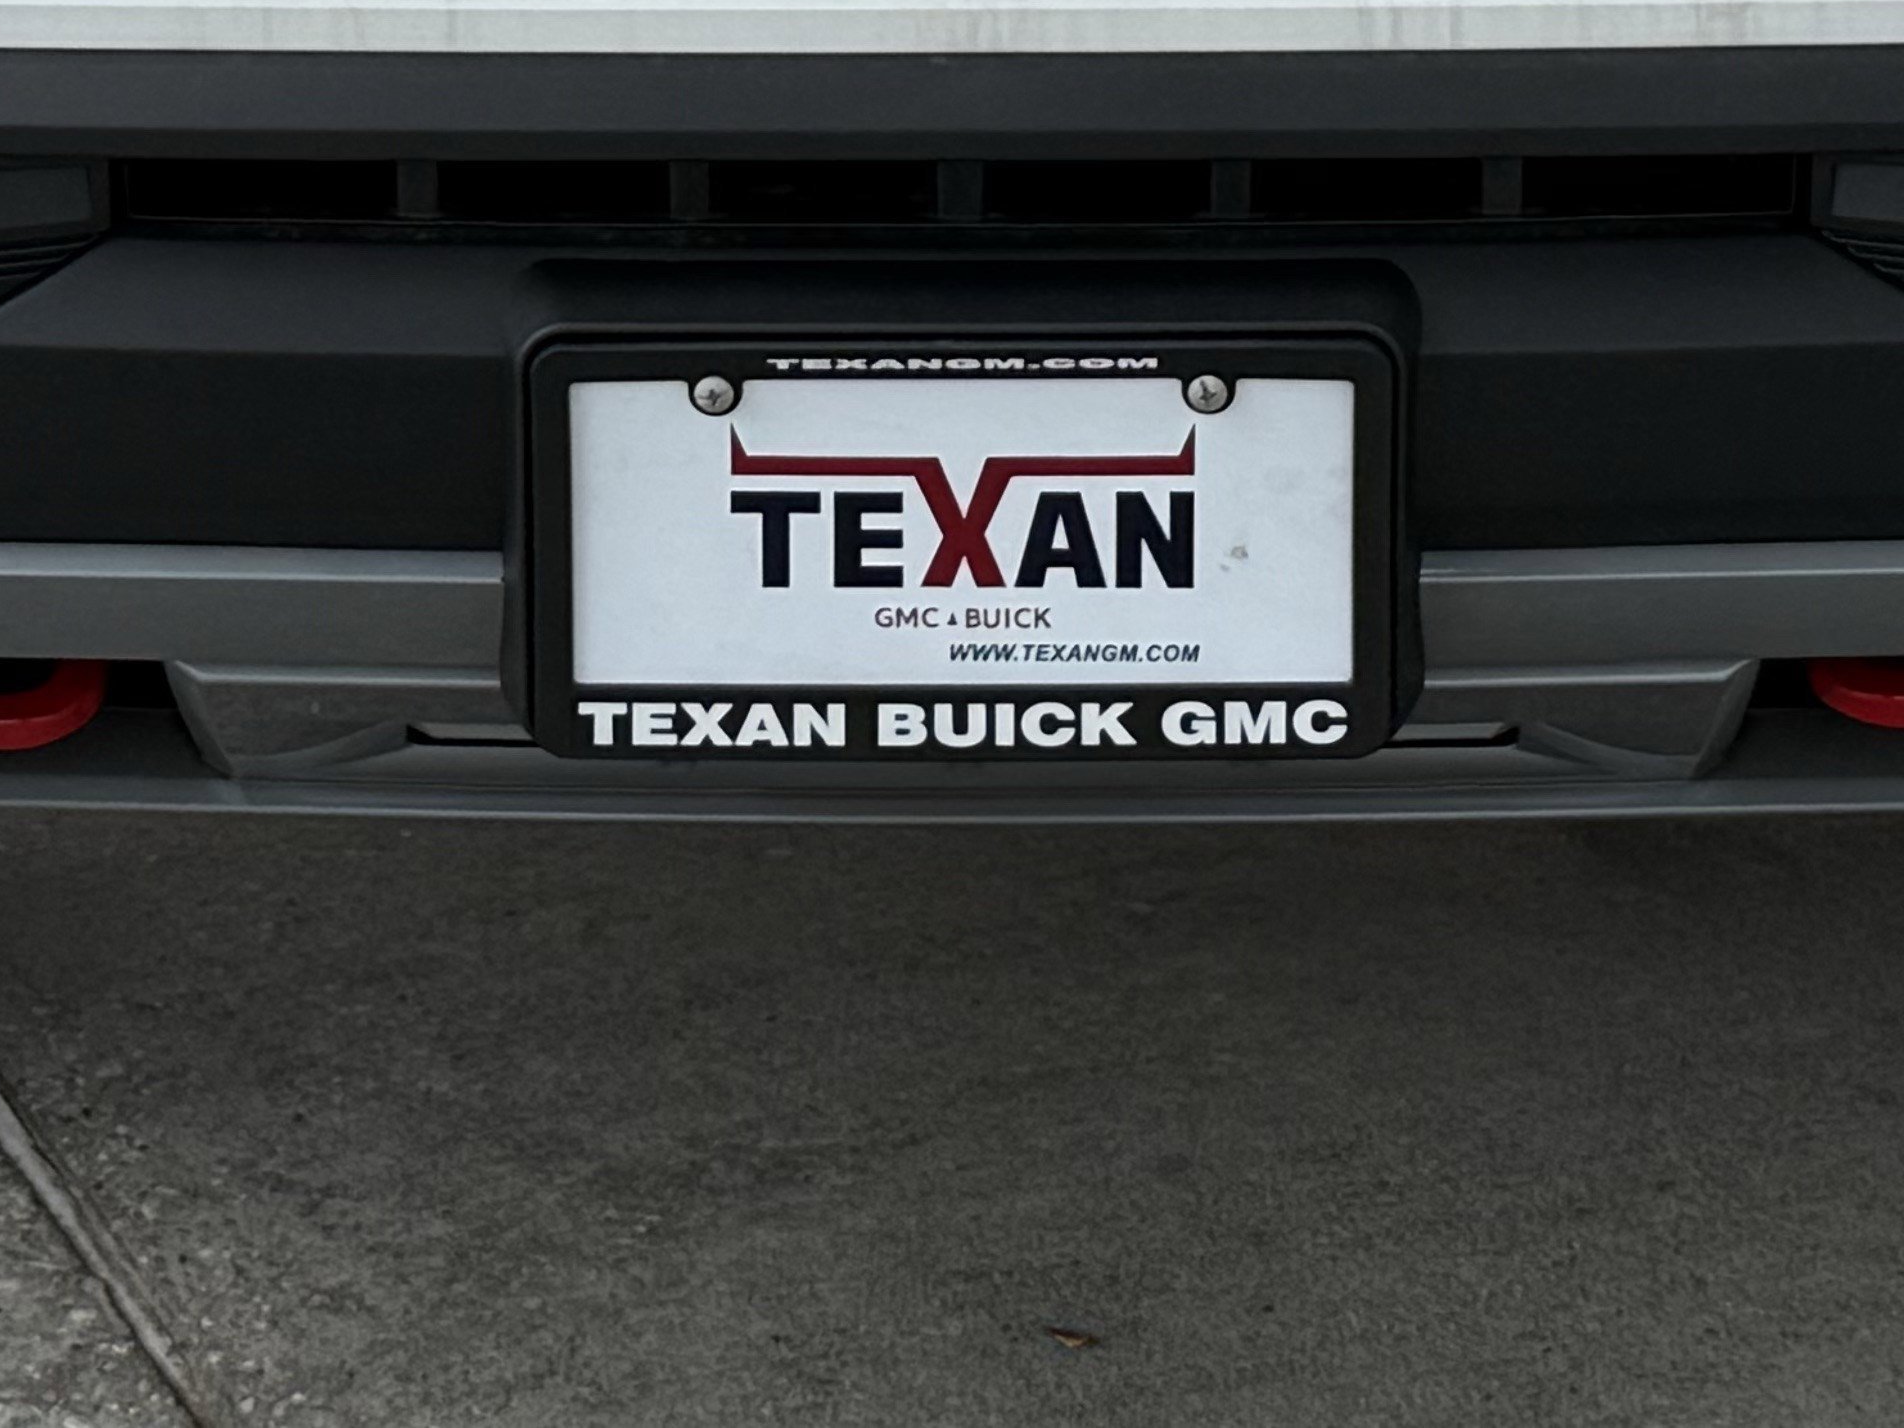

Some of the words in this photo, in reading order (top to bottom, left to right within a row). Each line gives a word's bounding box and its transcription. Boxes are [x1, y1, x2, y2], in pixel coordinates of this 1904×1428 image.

[730, 456, 1197, 590] TEXAN
[874, 607, 940, 629] GMC
[965, 607, 1052, 629] BUICK
[949, 643, 1201, 663] WWW.TEXANGM.COM
[578, 702, 846, 747] TEXAN
[876, 702, 1137, 747] BUICK
[1160, 700, 1349, 746] GMC
